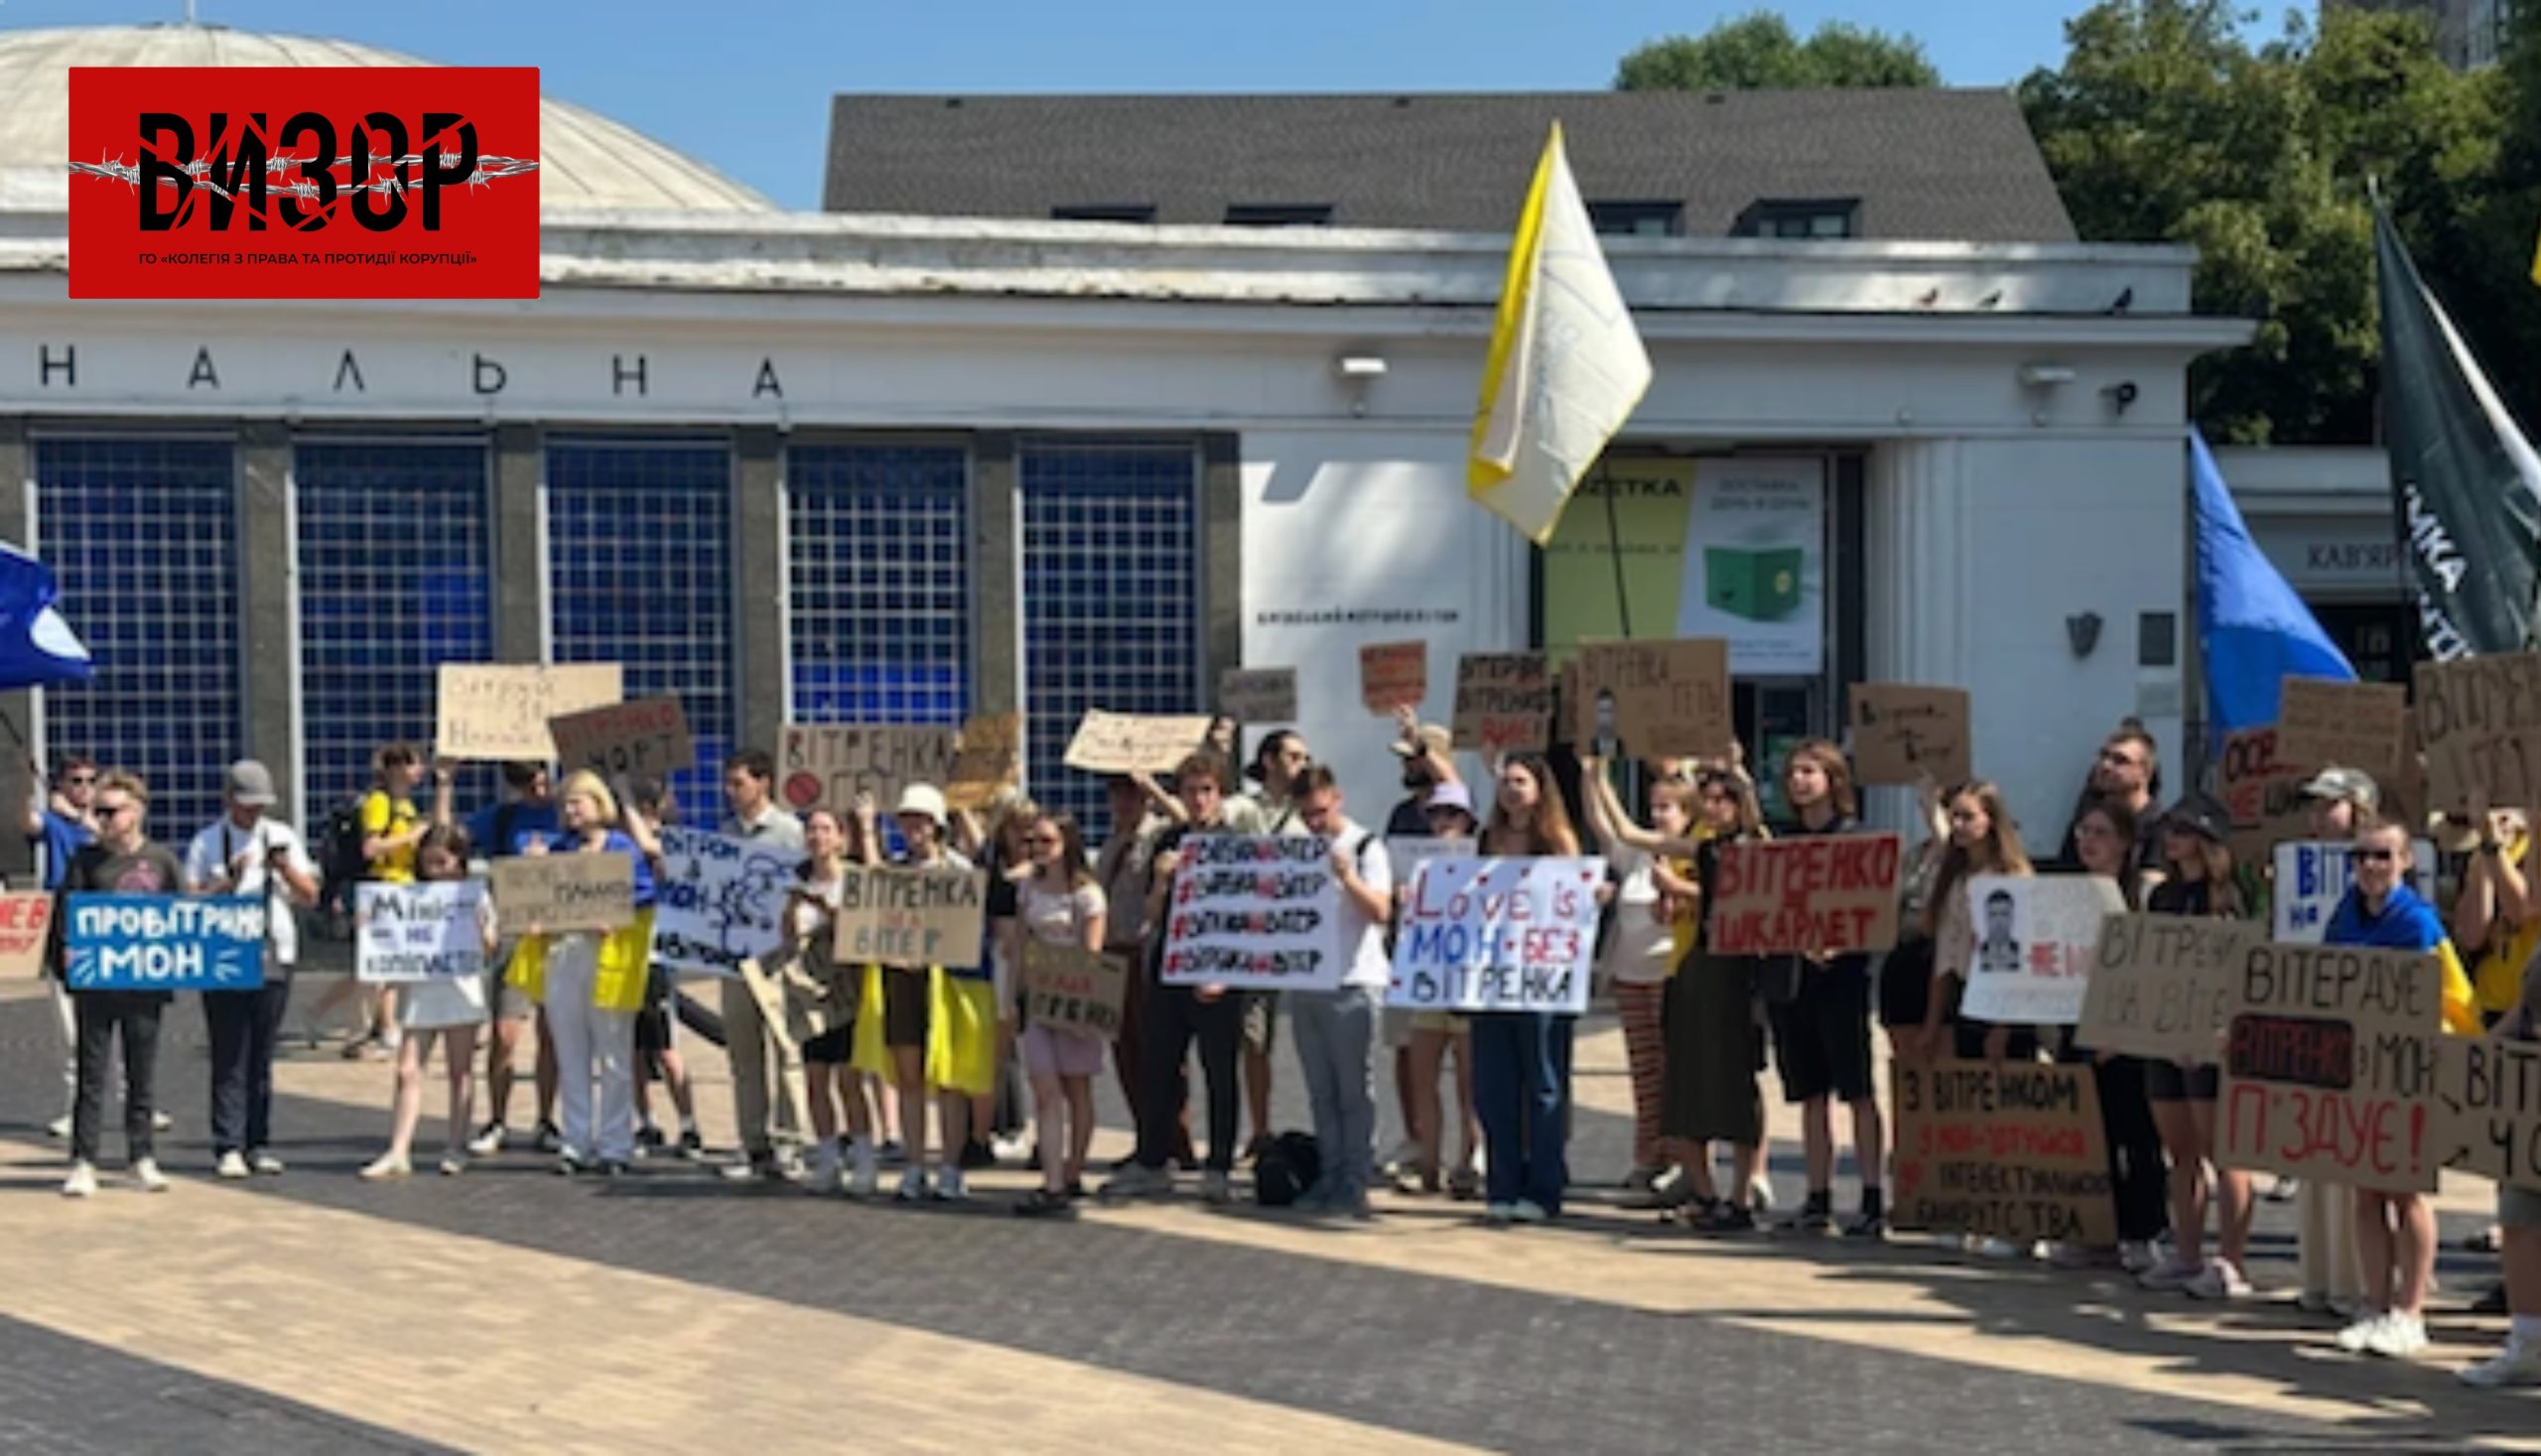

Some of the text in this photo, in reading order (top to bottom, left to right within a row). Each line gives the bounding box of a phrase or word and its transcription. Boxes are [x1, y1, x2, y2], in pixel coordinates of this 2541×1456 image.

[2308, 545, 2402, 570] КАВ'ЯР
[1718, 836, 1899, 897] ВІТРЕНКО
[99, 944, 204, 981] МОН
[1409, 924, 1580, 964] МОН БЕЗ
[1410, 966, 1572, 1002] ВІТРЕНКА
[2154, 976, 2227, 1033] ВІТЕ
[2467, 1043, 2541, 1113] ВІТ
